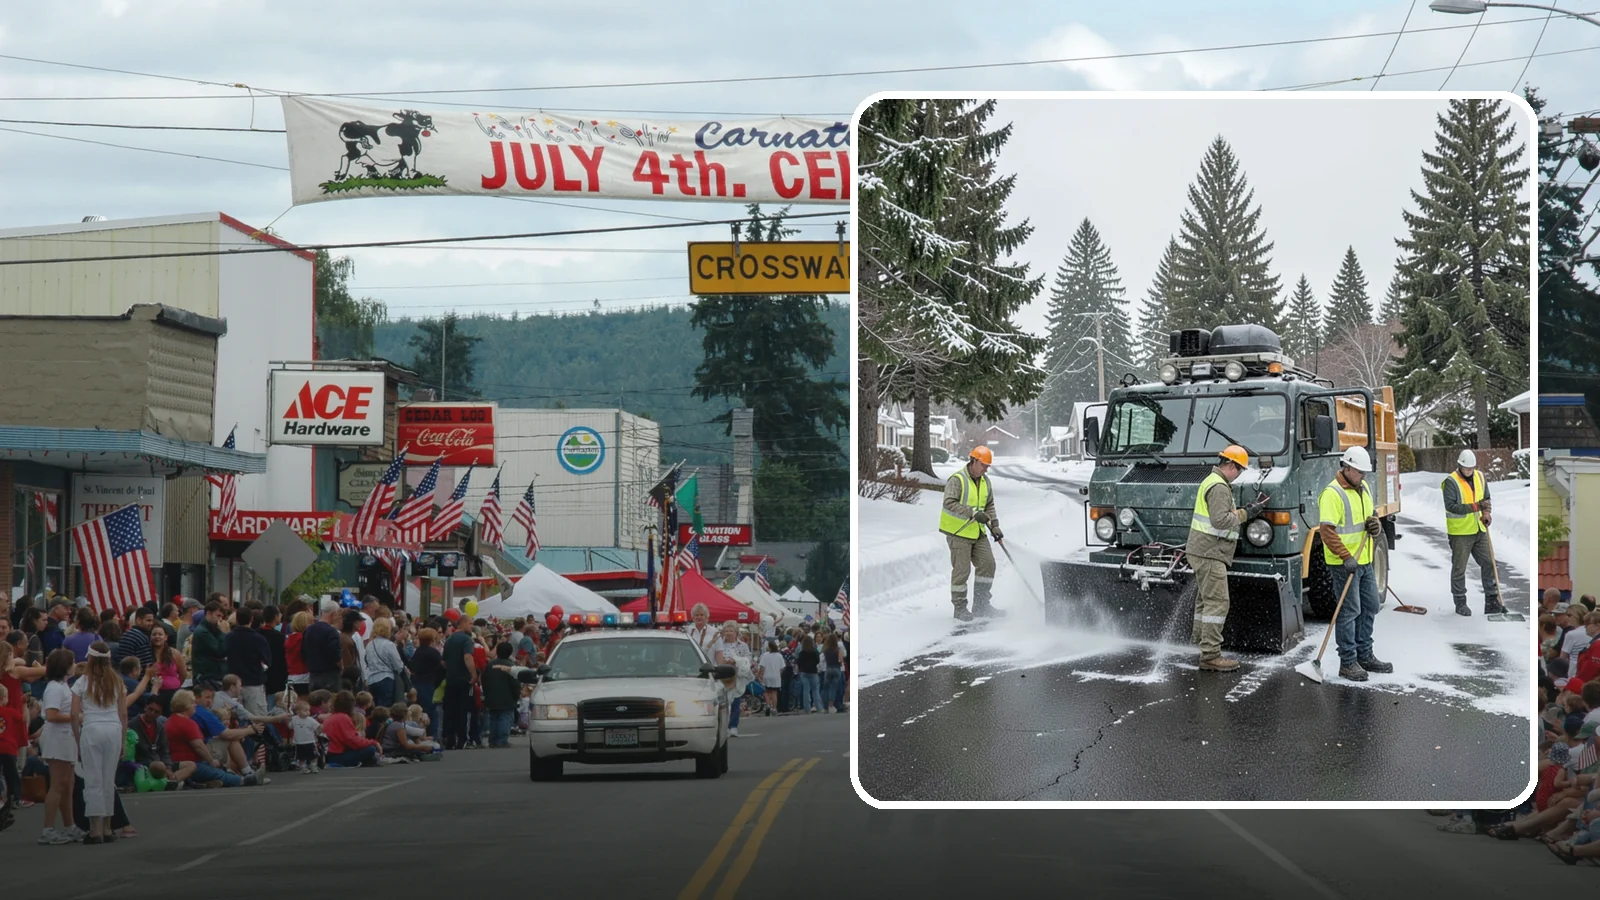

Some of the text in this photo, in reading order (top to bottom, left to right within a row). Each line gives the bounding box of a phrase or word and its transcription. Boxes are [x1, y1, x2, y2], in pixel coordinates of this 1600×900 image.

[695, 122, 850, 150] Carnat
[481, 141, 605, 192] JULY
[632, 150, 746, 197] 4th.
[697, 254, 850, 280] CROSSWA
[282, 380, 373, 420] ACE
[405, 409, 452, 422] CEDAR
[283, 421, 370, 436] Hardware
[416, 428, 476, 447] Coca-Cola
[95, 485, 124, 494] Vincent
[126, 486, 135, 494] de
[137, 486, 155, 495] Paul
[212, 516, 330, 535] HARDARE
[688, 526, 741, 535] CRNATION
[699, 535, 730, 543] GLASS
